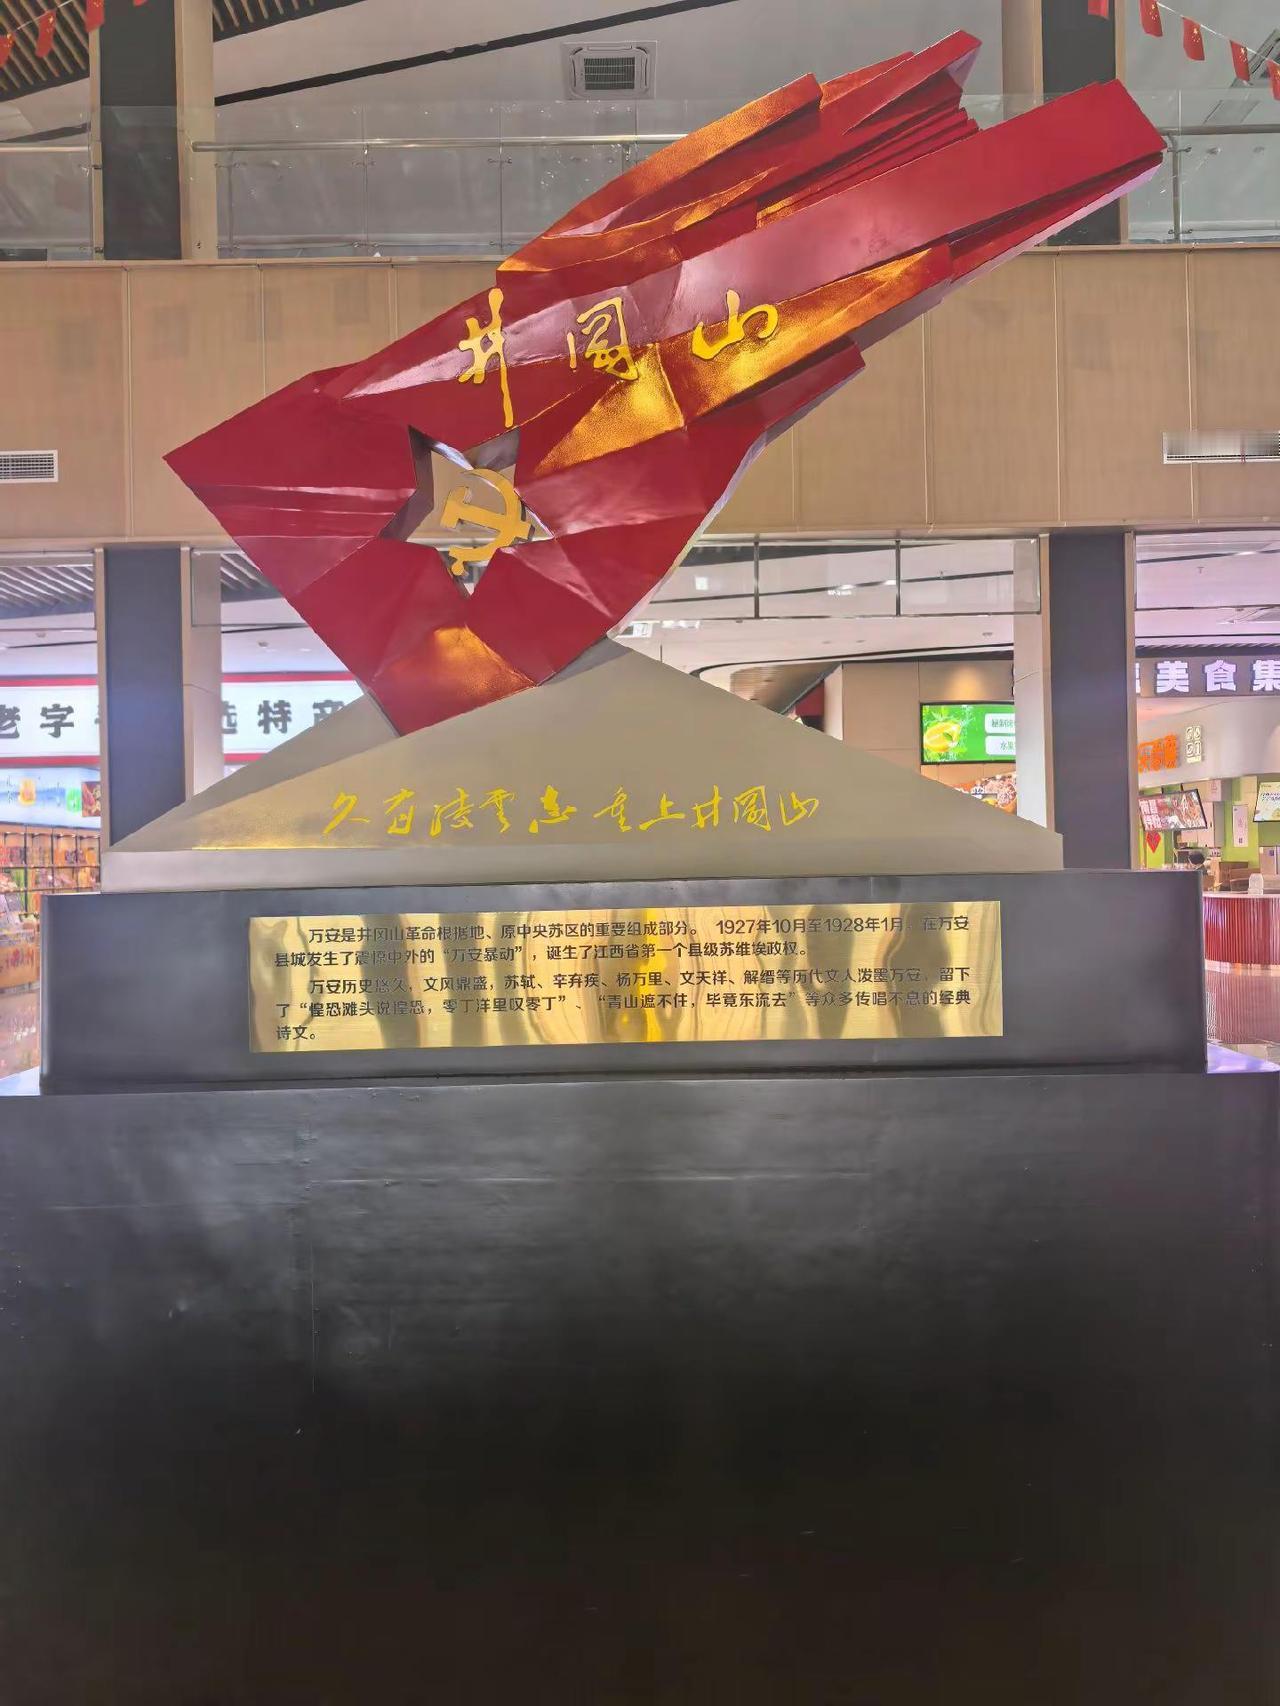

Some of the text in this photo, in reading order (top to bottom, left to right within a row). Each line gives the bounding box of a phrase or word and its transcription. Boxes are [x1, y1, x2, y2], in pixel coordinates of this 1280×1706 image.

[1135, 660, 1280, 693] 美食集
[0, 703, 100, 739] 老字
[276, 1025, 317, 1041] 诗文。
